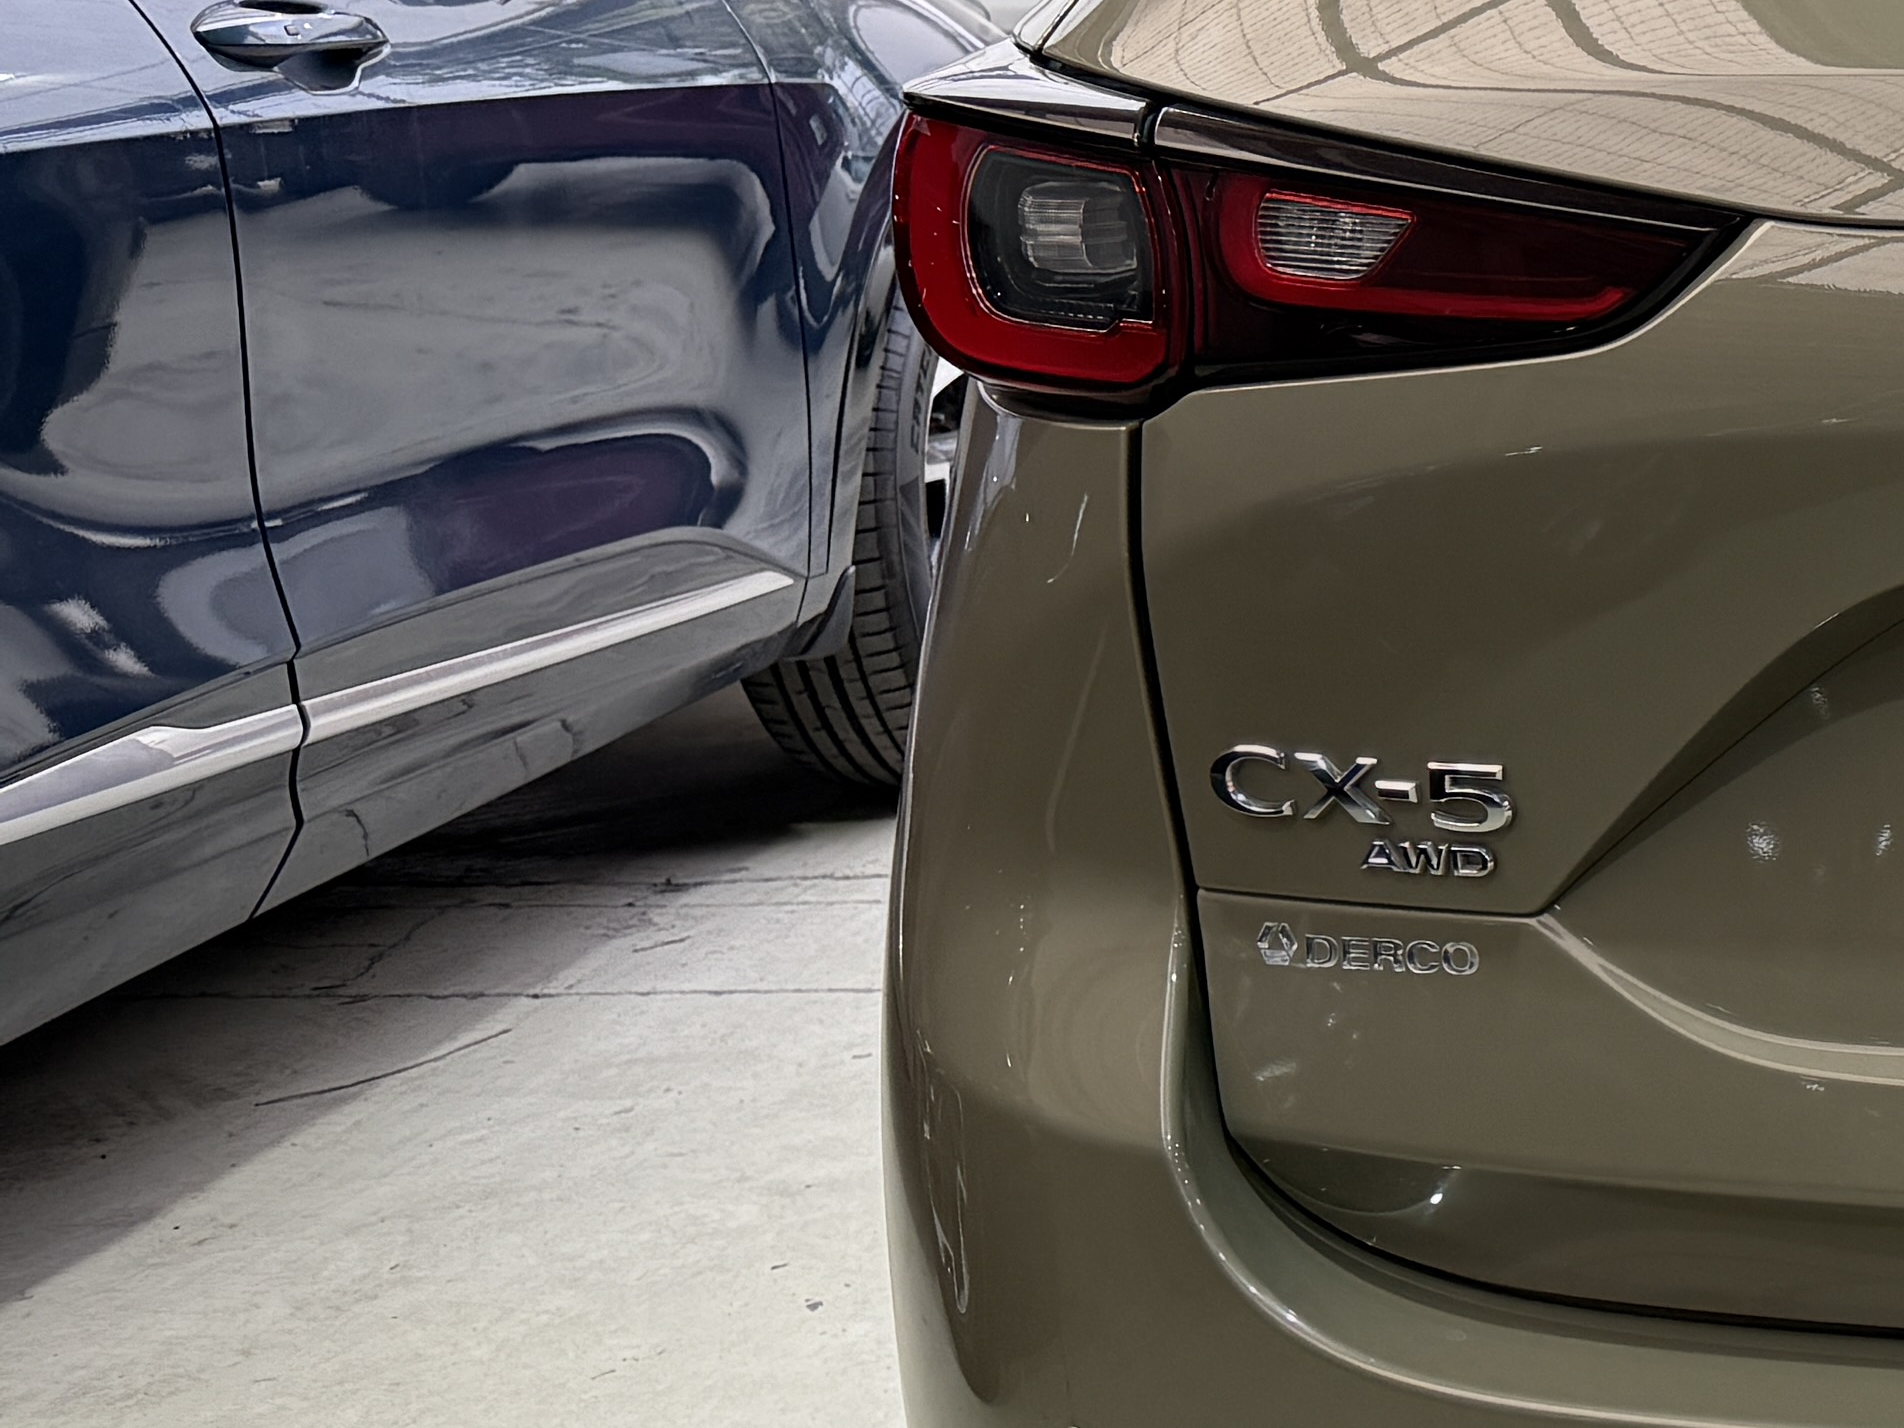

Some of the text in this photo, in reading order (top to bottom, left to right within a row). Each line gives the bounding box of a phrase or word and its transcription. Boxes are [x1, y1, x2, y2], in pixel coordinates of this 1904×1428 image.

[1209, 744, 1516, 833] CX-5
[1360, 838, 1497, 878] AWD
[1304, 933, 1481, 976] DERCO
